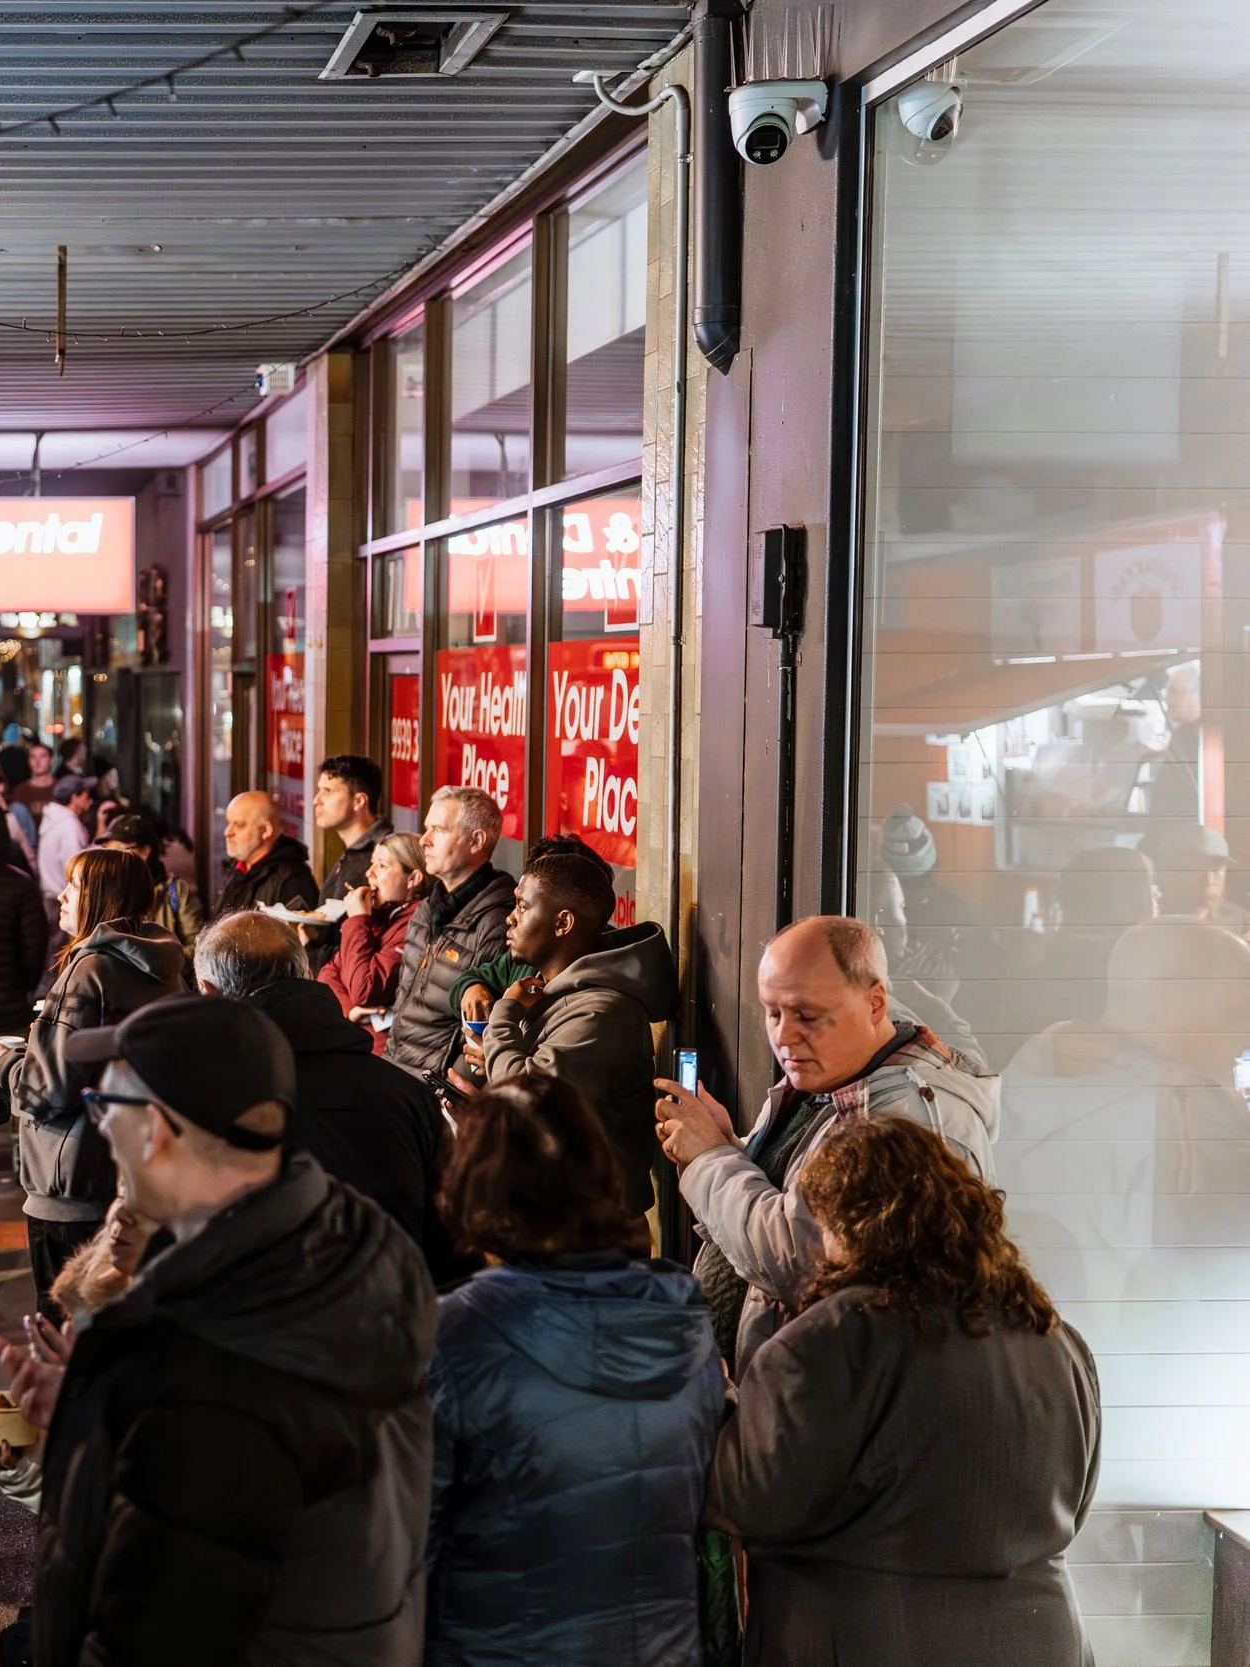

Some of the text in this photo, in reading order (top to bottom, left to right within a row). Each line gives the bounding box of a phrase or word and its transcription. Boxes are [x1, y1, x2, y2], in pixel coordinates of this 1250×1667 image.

[441, 672, 476, 732] Your
[553, 670, 604, 740] Your
[461, 744, 510, 810] Place
[582, 757, 638, 836] Plac
